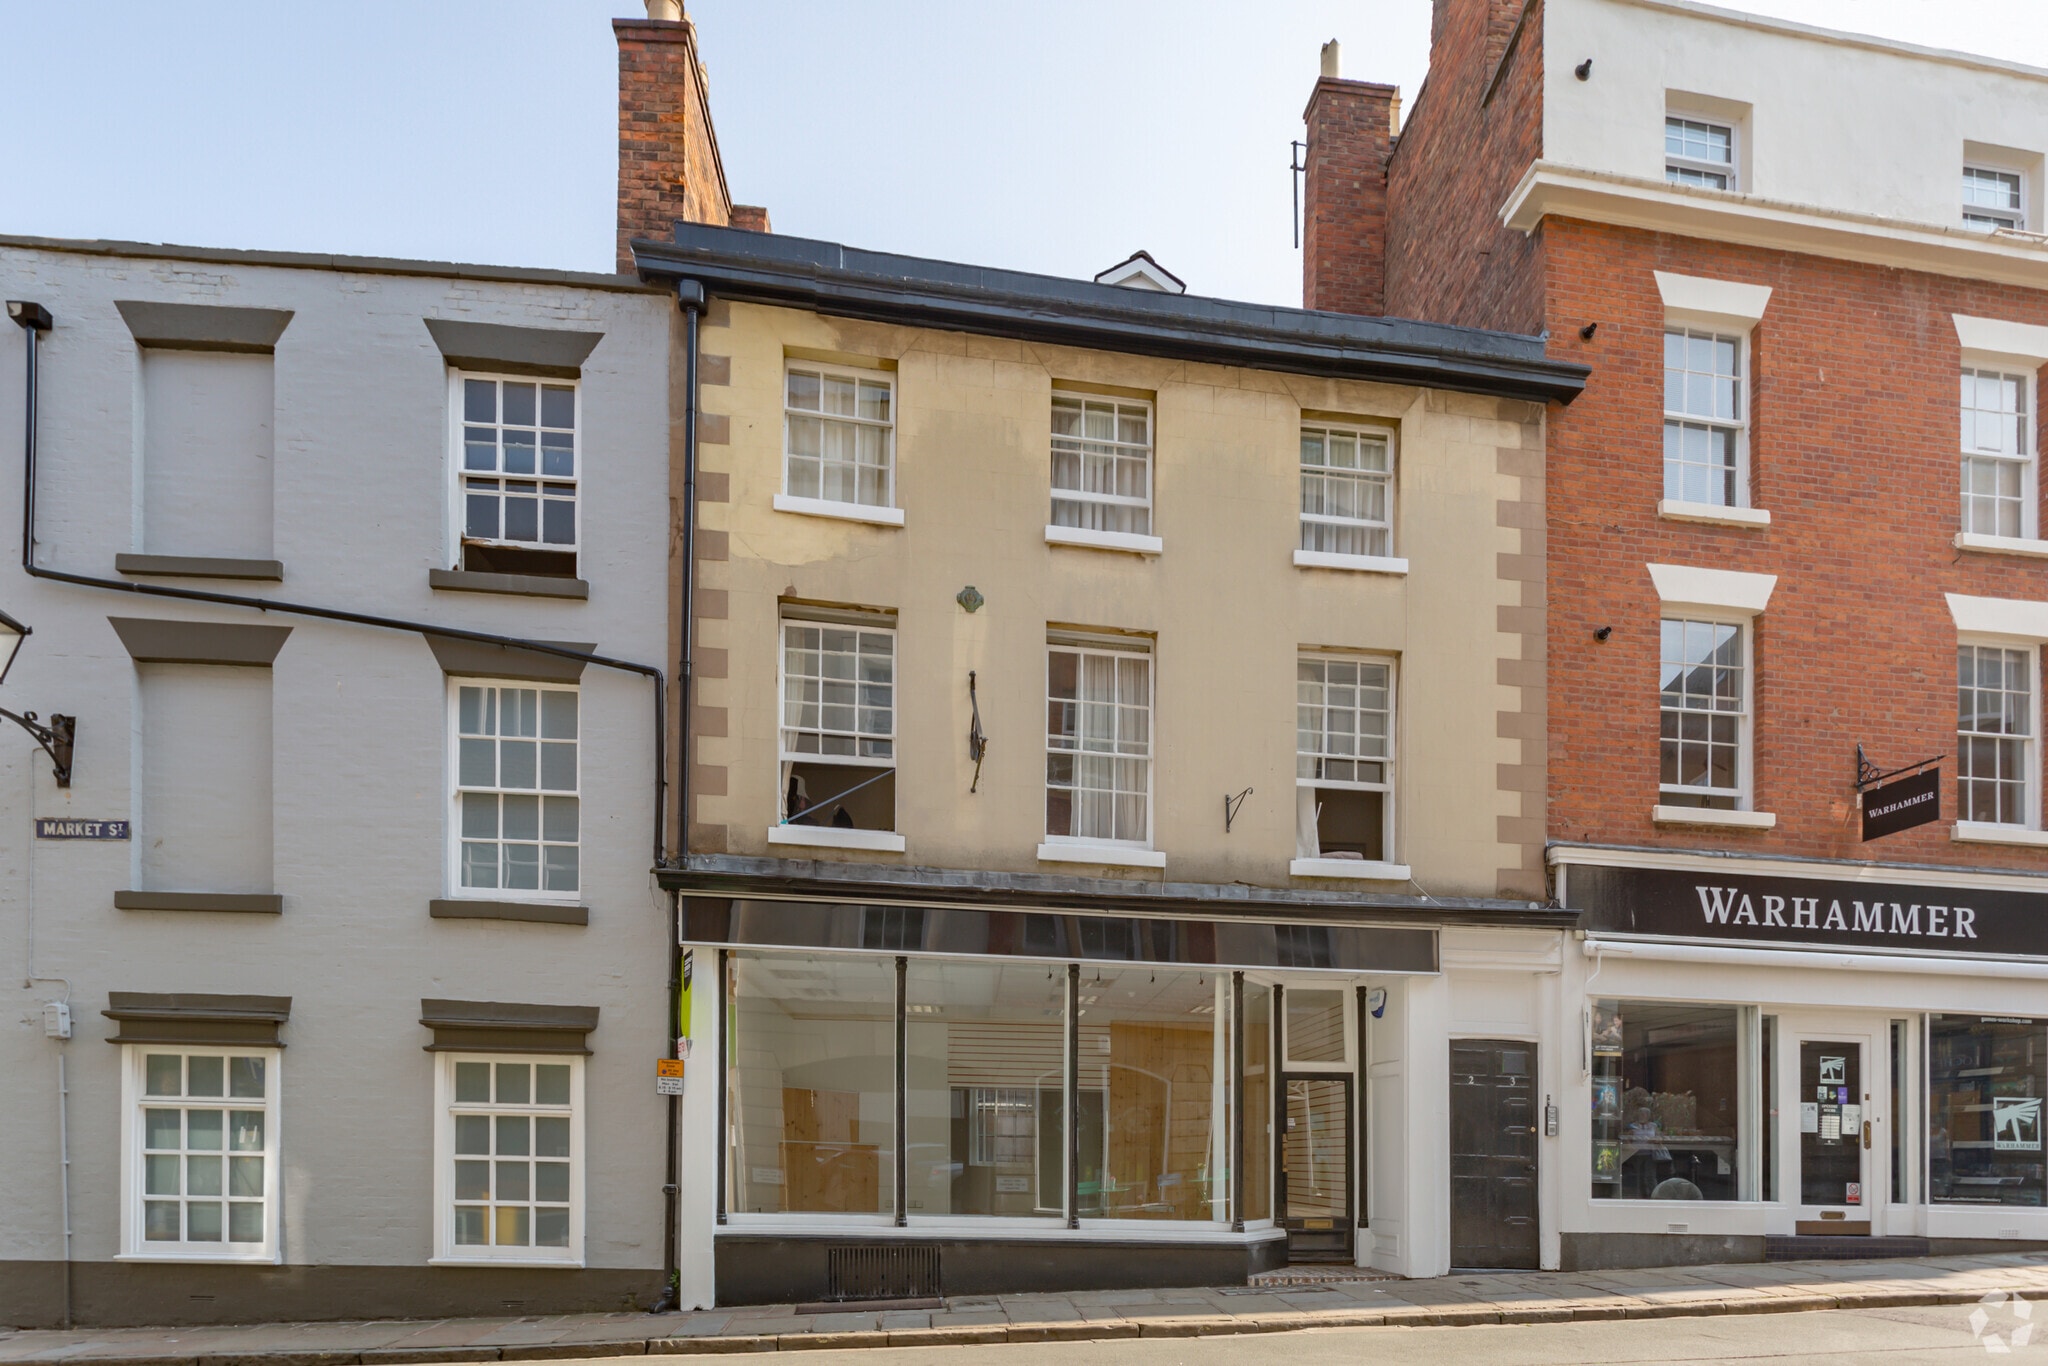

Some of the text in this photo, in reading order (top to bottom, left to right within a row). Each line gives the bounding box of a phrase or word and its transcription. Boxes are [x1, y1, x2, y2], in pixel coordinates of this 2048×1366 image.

[1868, 791, 1935, 819] WARHAMMER
[44, 822, 102, 836] MARKET
[1695, 886, 1978, 939] WARHAMMER
[1468, 1075, 1474, 1085] 2
[1510, 1077, 1516, 1087] 3
